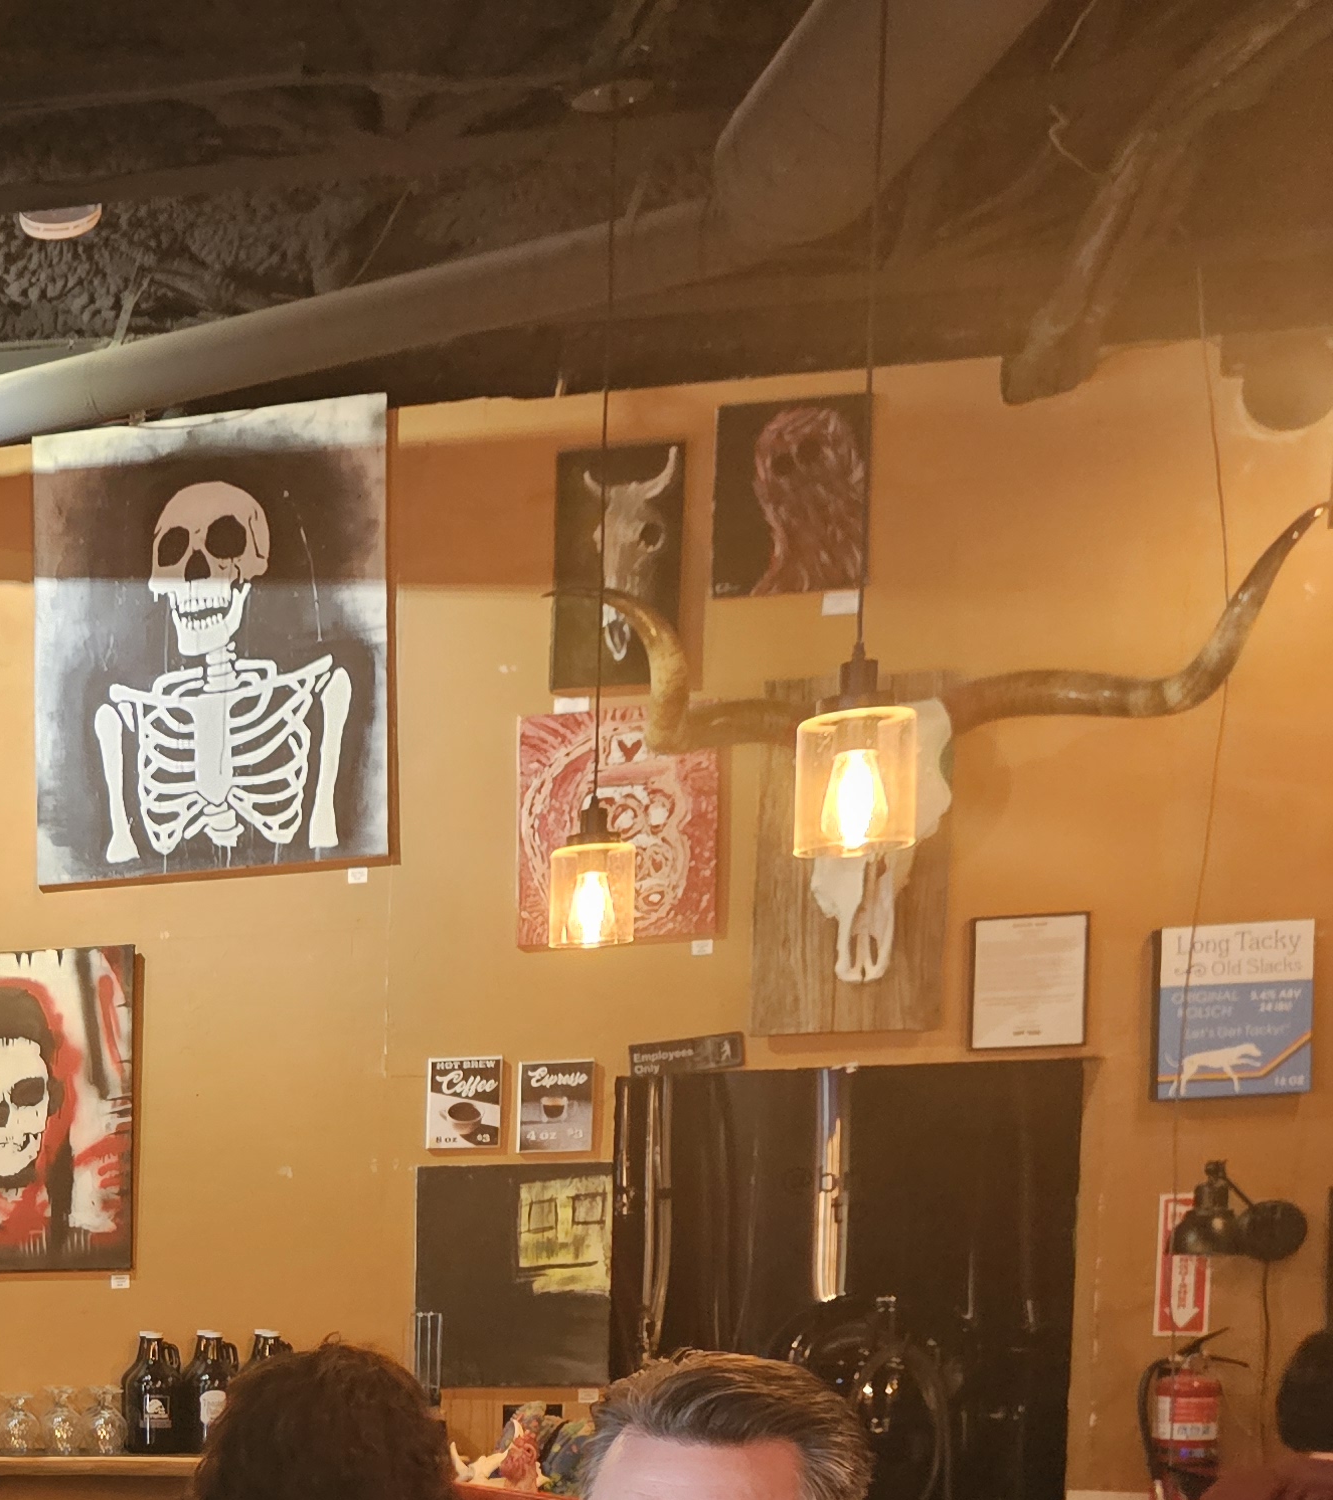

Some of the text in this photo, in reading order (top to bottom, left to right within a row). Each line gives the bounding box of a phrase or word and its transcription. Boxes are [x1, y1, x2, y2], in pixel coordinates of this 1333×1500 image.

[1176, 929, 1301, 958] Long Tacky
[1211, 957, 1303, 977] Old Slacks
[436, 1060, 496, 1070] HOT BREW
[633, 1048, 694, 1063] Employees
[528, 1066, 589, 1089] Espresso
[634, 1064, 660, 1075] Only
[435, 1069, 499, 1098] Coffee
